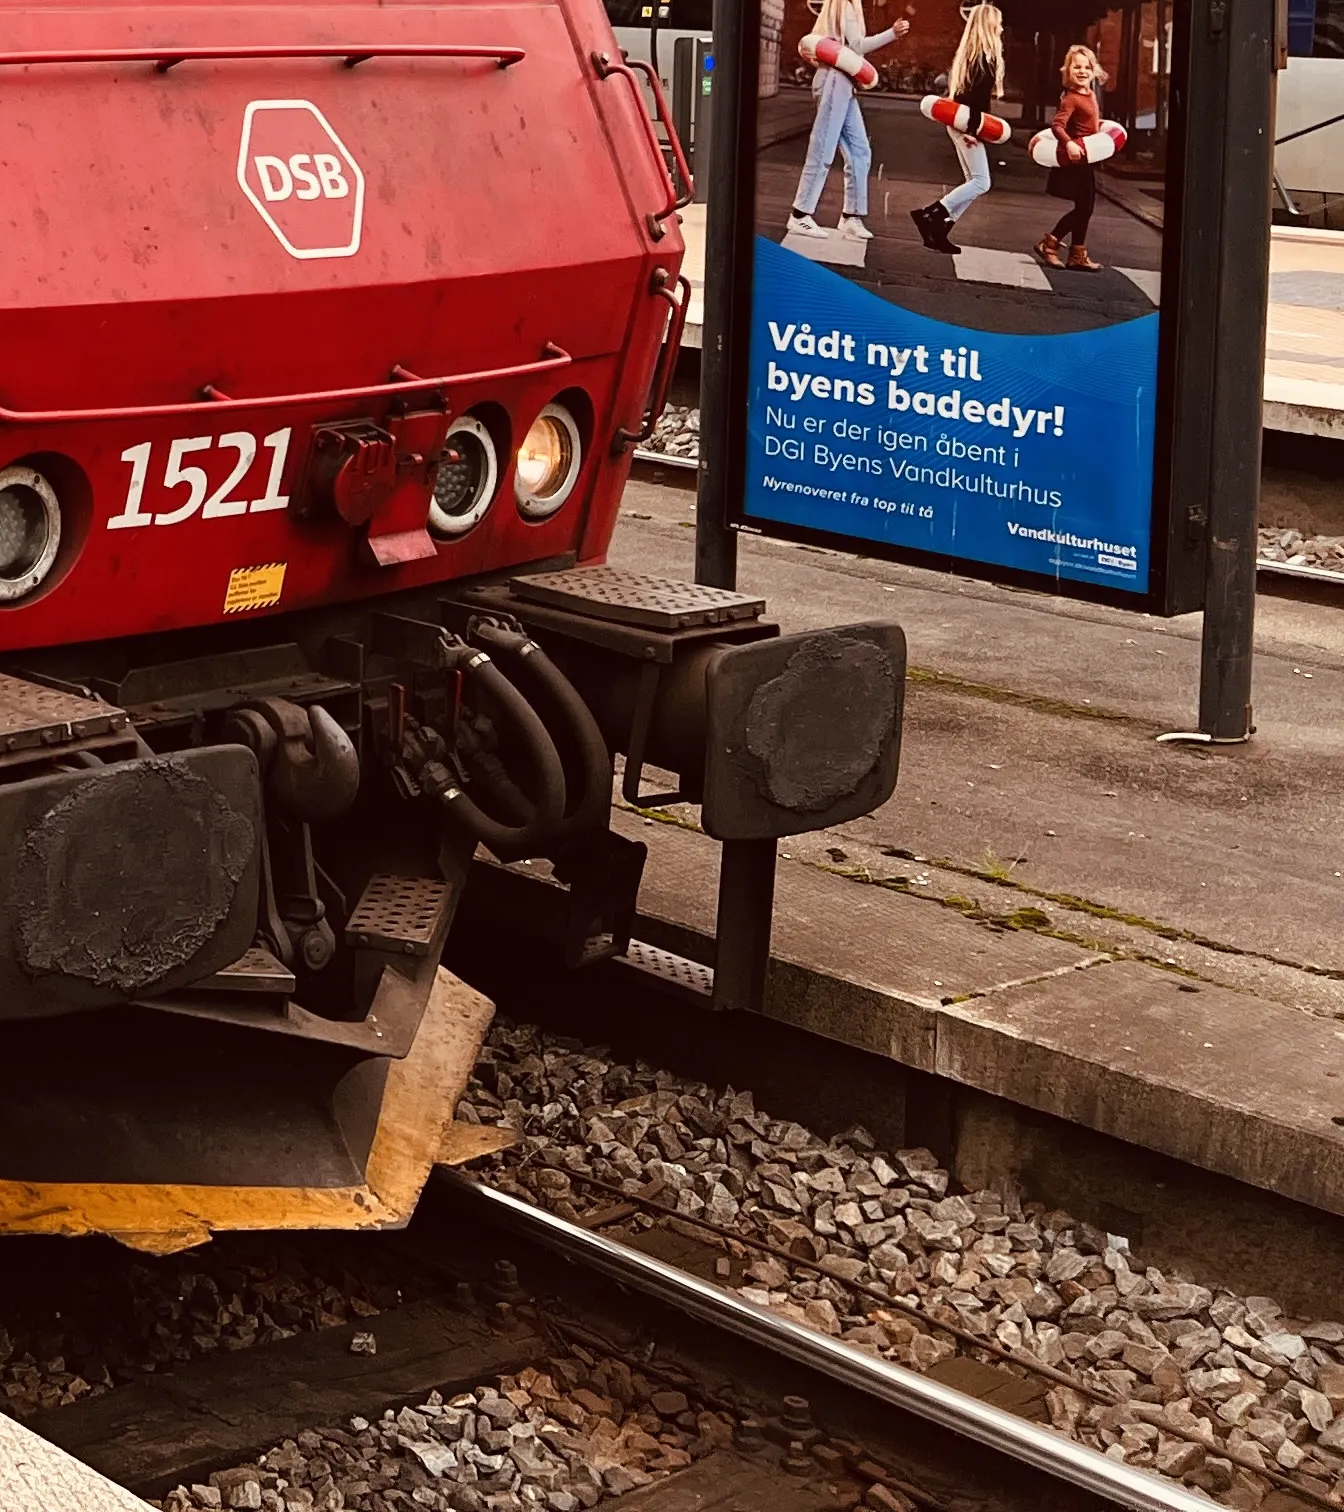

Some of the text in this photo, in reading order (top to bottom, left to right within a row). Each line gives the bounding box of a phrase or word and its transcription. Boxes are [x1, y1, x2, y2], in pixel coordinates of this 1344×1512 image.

[254, 153, 349, 202] DSB
[768, 321, 982, 381] Vådt nyt til
[767, 361, 1064, 437] byens badedyr!
[766, 406, 1019, 468] Nu er der igen åbent i
[107, 427, 292, 530] 1521
[763, 475, 934, 519] Nyrenoveret fra top til tå
[765, 436, 1062, 508] DGI Byens Vandkulturhus
[1007, 521, 1137, 558] Vandkulturhuset
